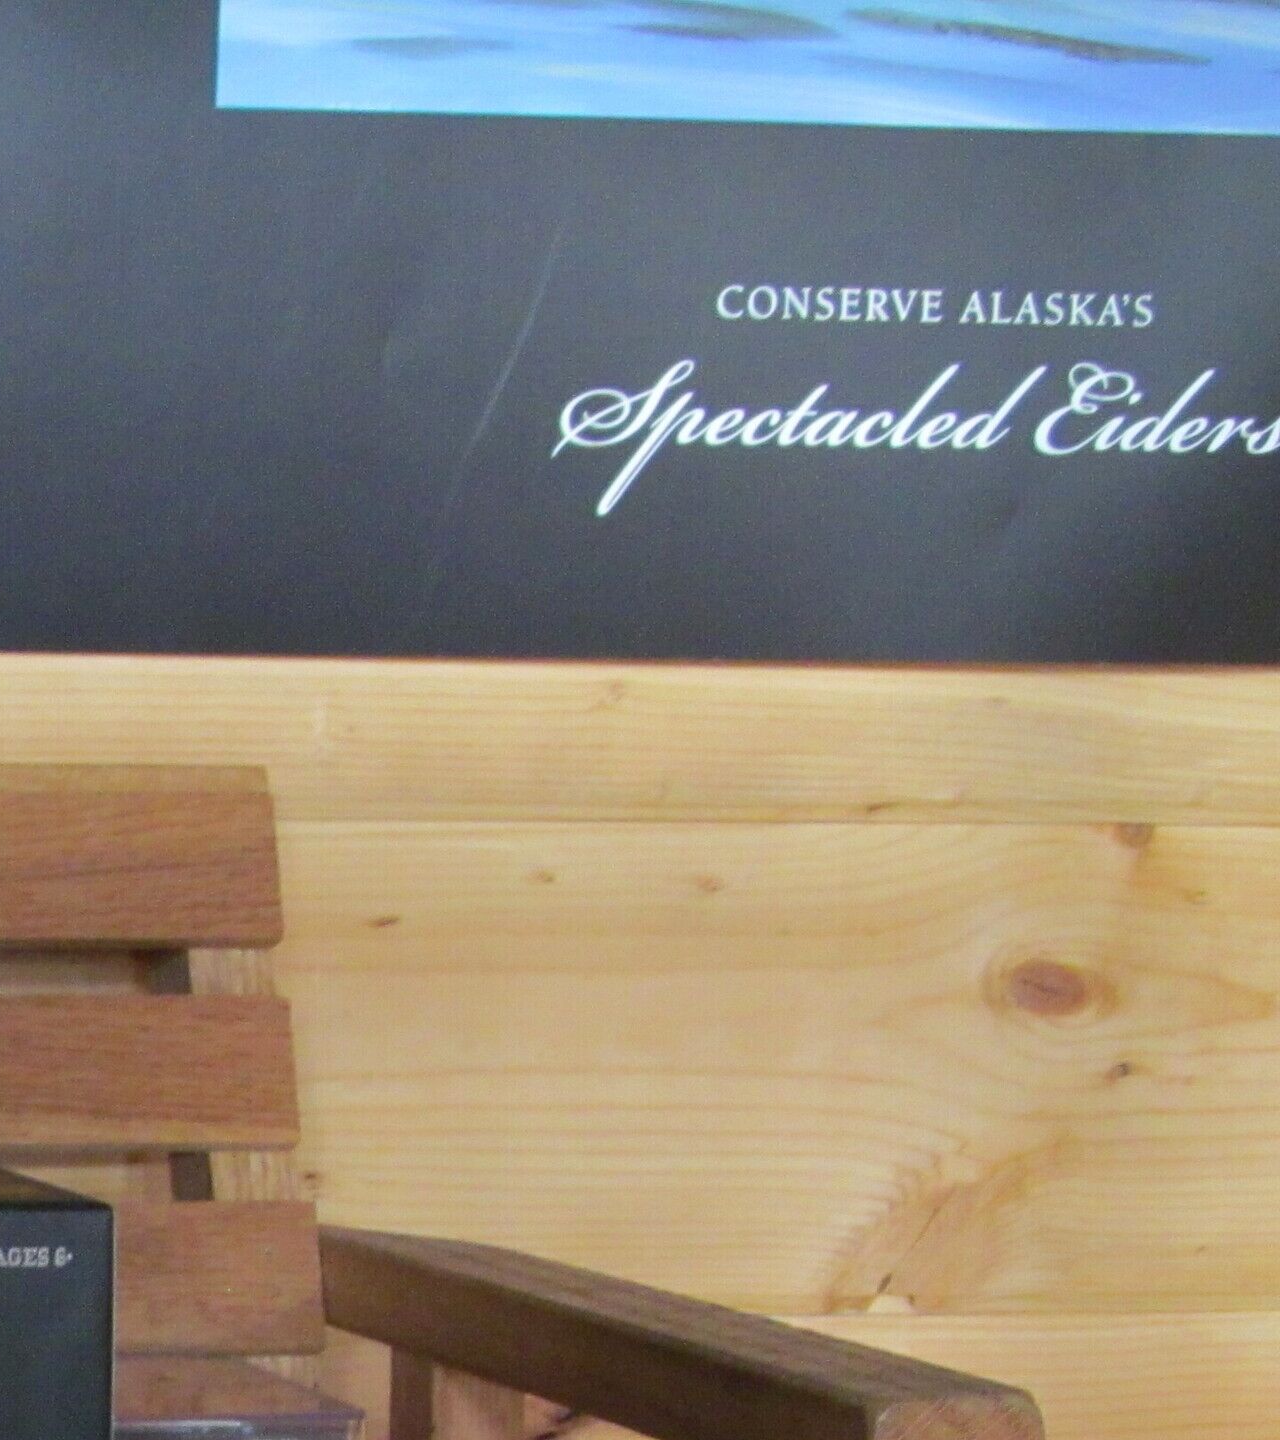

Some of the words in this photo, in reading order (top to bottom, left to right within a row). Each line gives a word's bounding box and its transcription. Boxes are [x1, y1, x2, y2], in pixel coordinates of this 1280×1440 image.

[716, 284, 944, 324] CONSERVE
[958, 290, 1154, 328] ALASKA'S
[551, 359, 1047, 516] Spectacled
[1033, 362, 1280, 457] Eiders
